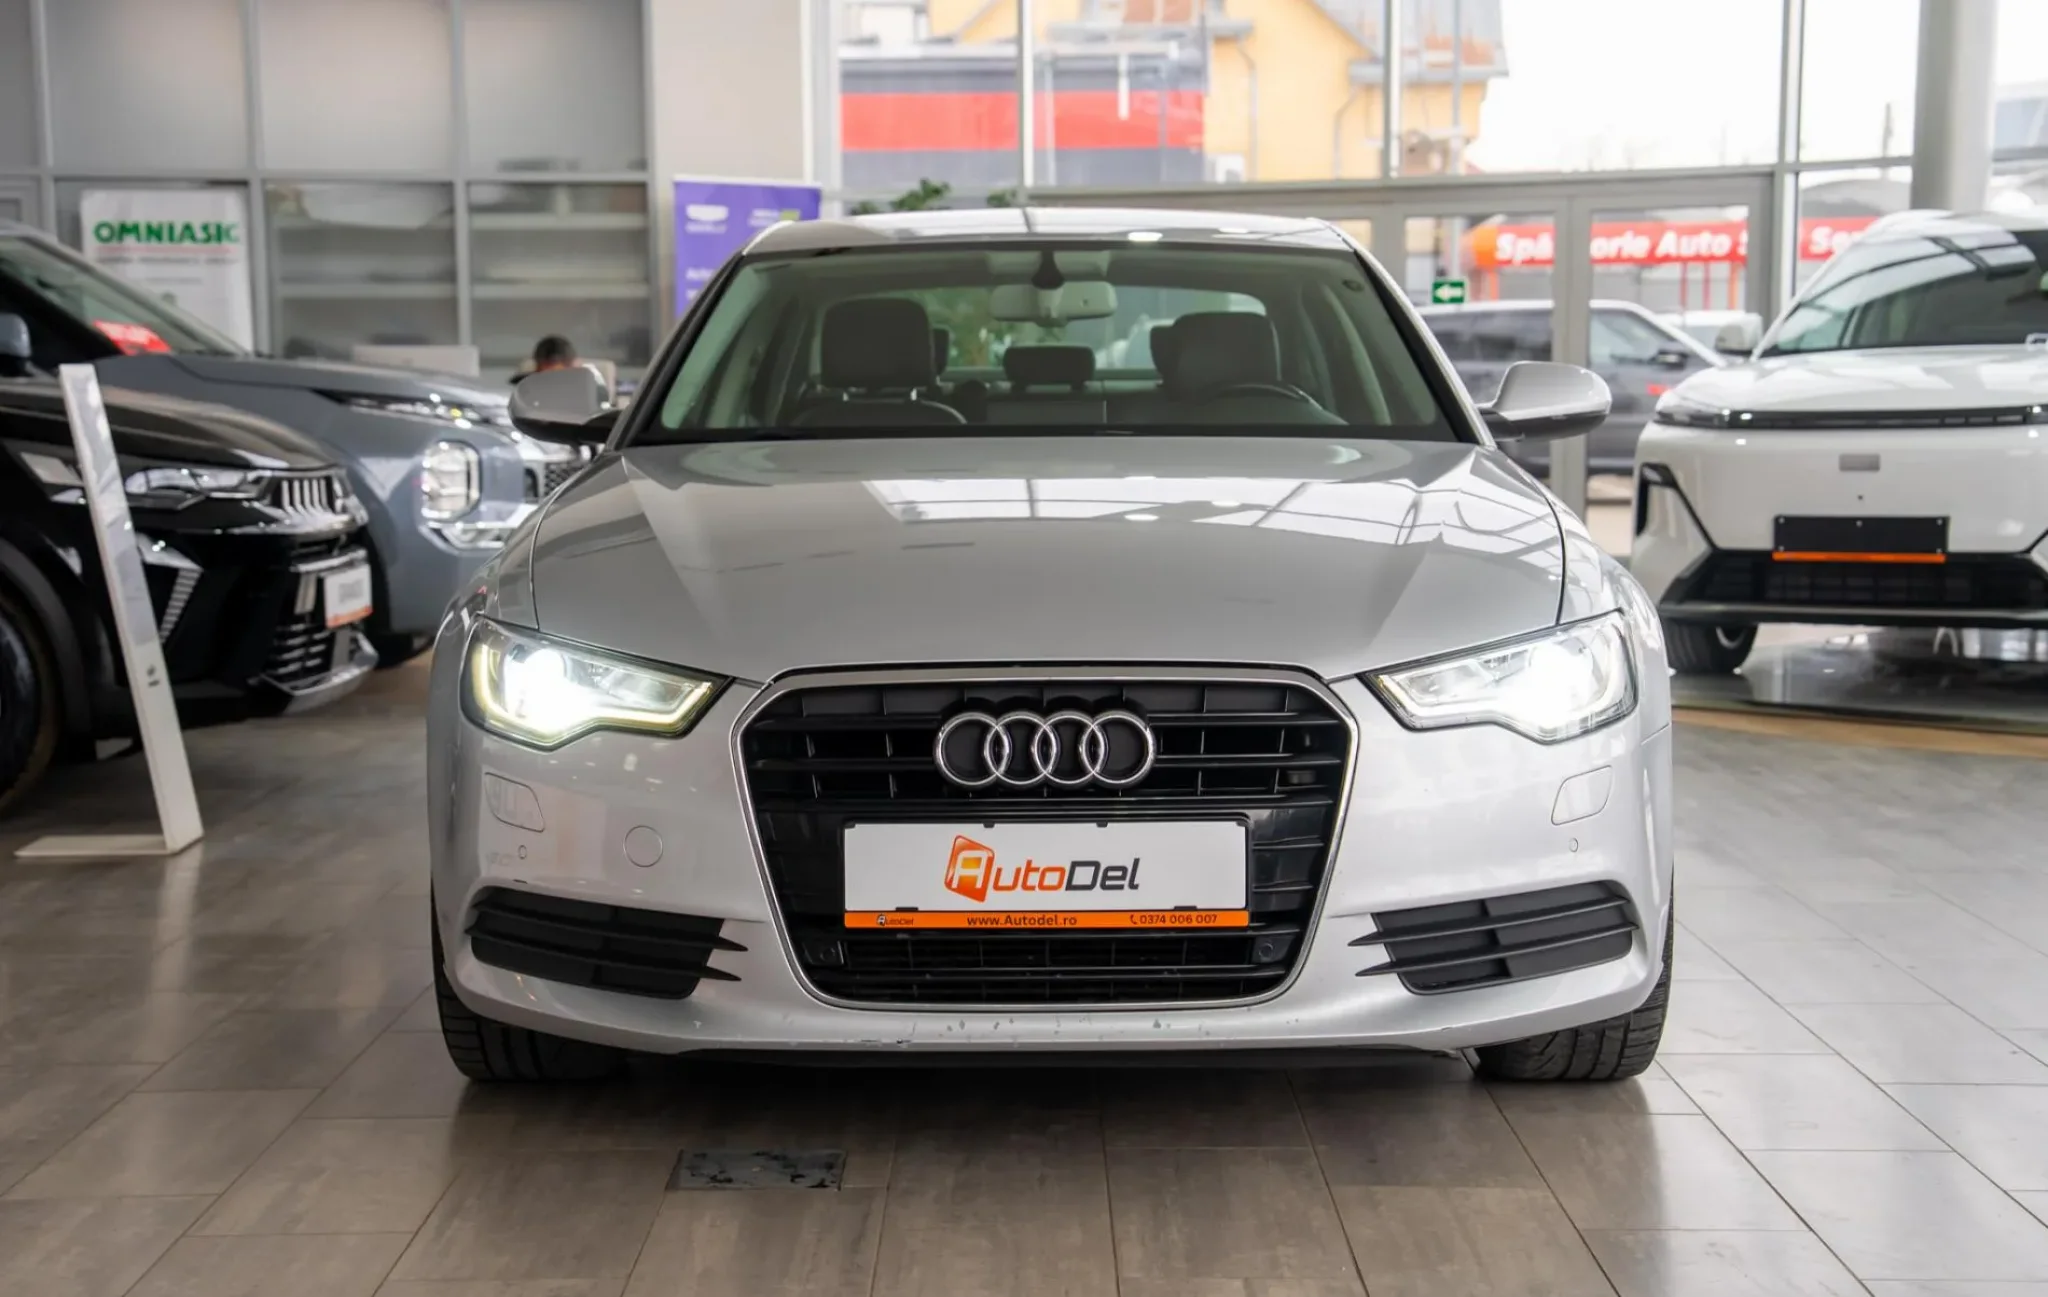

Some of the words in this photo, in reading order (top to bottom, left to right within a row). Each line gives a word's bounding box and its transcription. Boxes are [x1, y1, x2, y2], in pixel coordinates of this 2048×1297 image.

[1655, 229, 1732, 258] Auto
[949, 848, 1141, 893] AutoDel
[966, 914, 1078, 926] www.Autodel.ro
[1139, 914, 1167, 925] 0374
[1169, 914, 1193, 925] 006
[1195, 914, 1218, 924] 007
